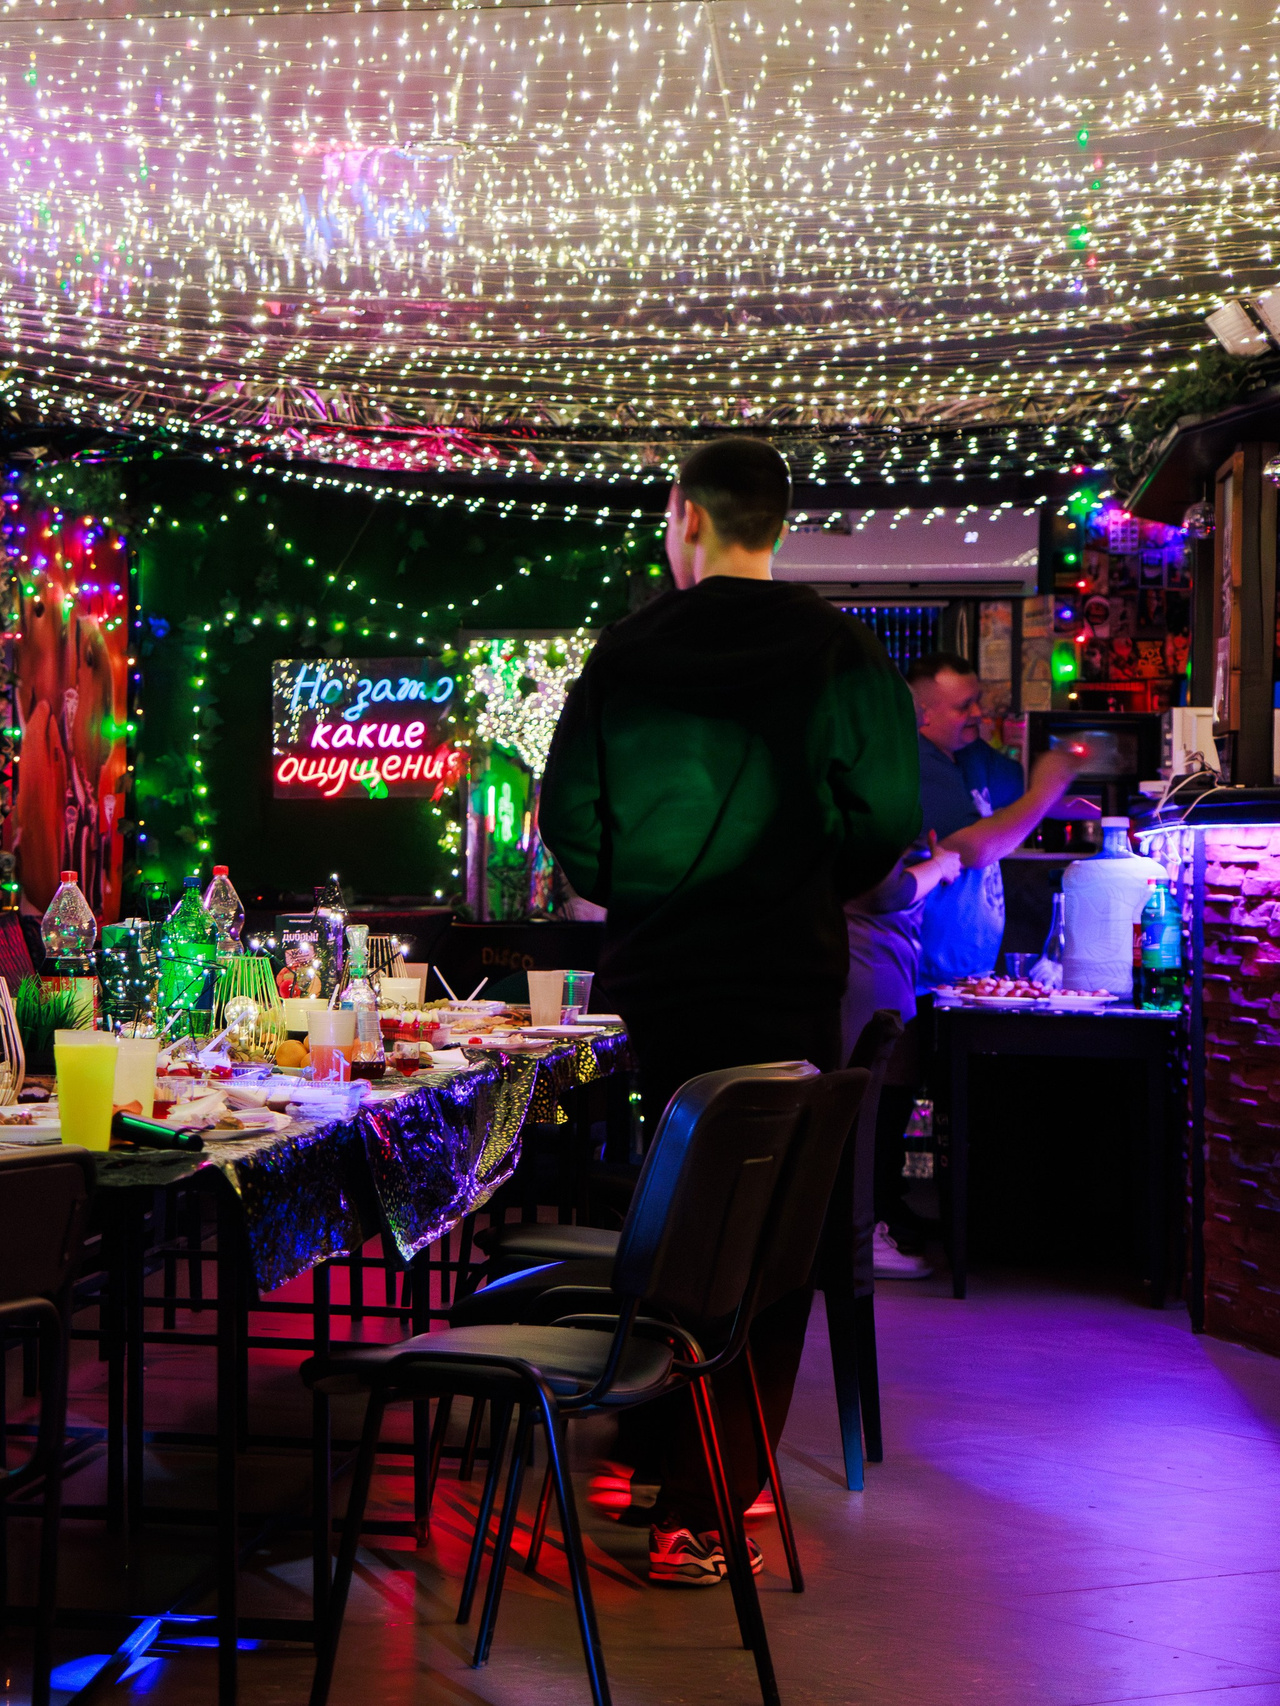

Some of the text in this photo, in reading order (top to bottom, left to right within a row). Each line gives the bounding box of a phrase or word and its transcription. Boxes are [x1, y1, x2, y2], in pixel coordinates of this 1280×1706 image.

[290, 663, 455, 722] Но зато
[310, 720, 426, 750] какие
